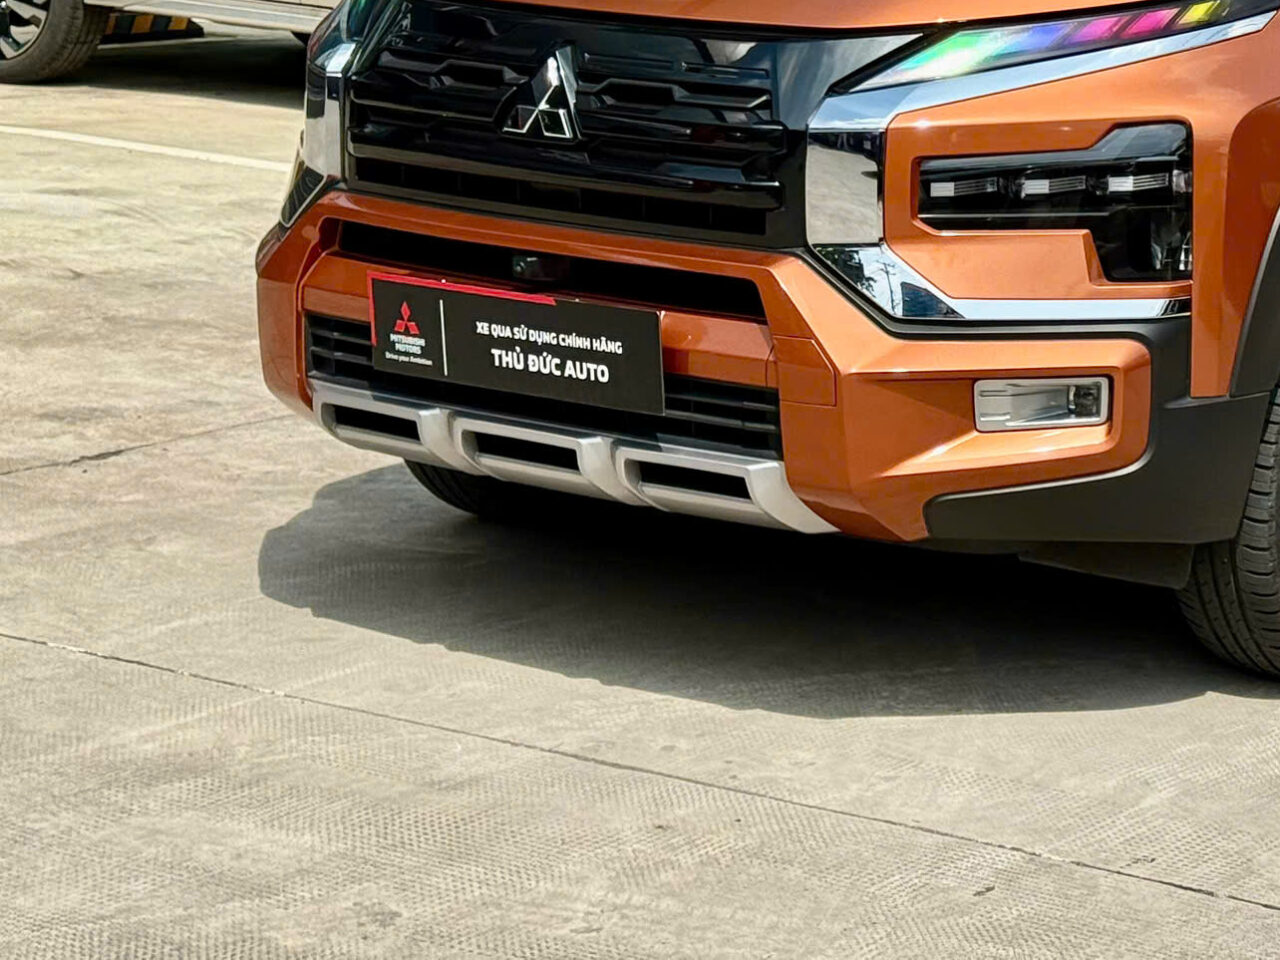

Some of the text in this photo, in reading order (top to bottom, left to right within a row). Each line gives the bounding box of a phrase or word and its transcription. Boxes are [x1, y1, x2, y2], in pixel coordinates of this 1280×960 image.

[476, 321, 623, 354] XE QUA SỬ DỤNG CHÍNH HÃNG
[491, 346, 609, 383] THỦ ĐỨC AUTO
